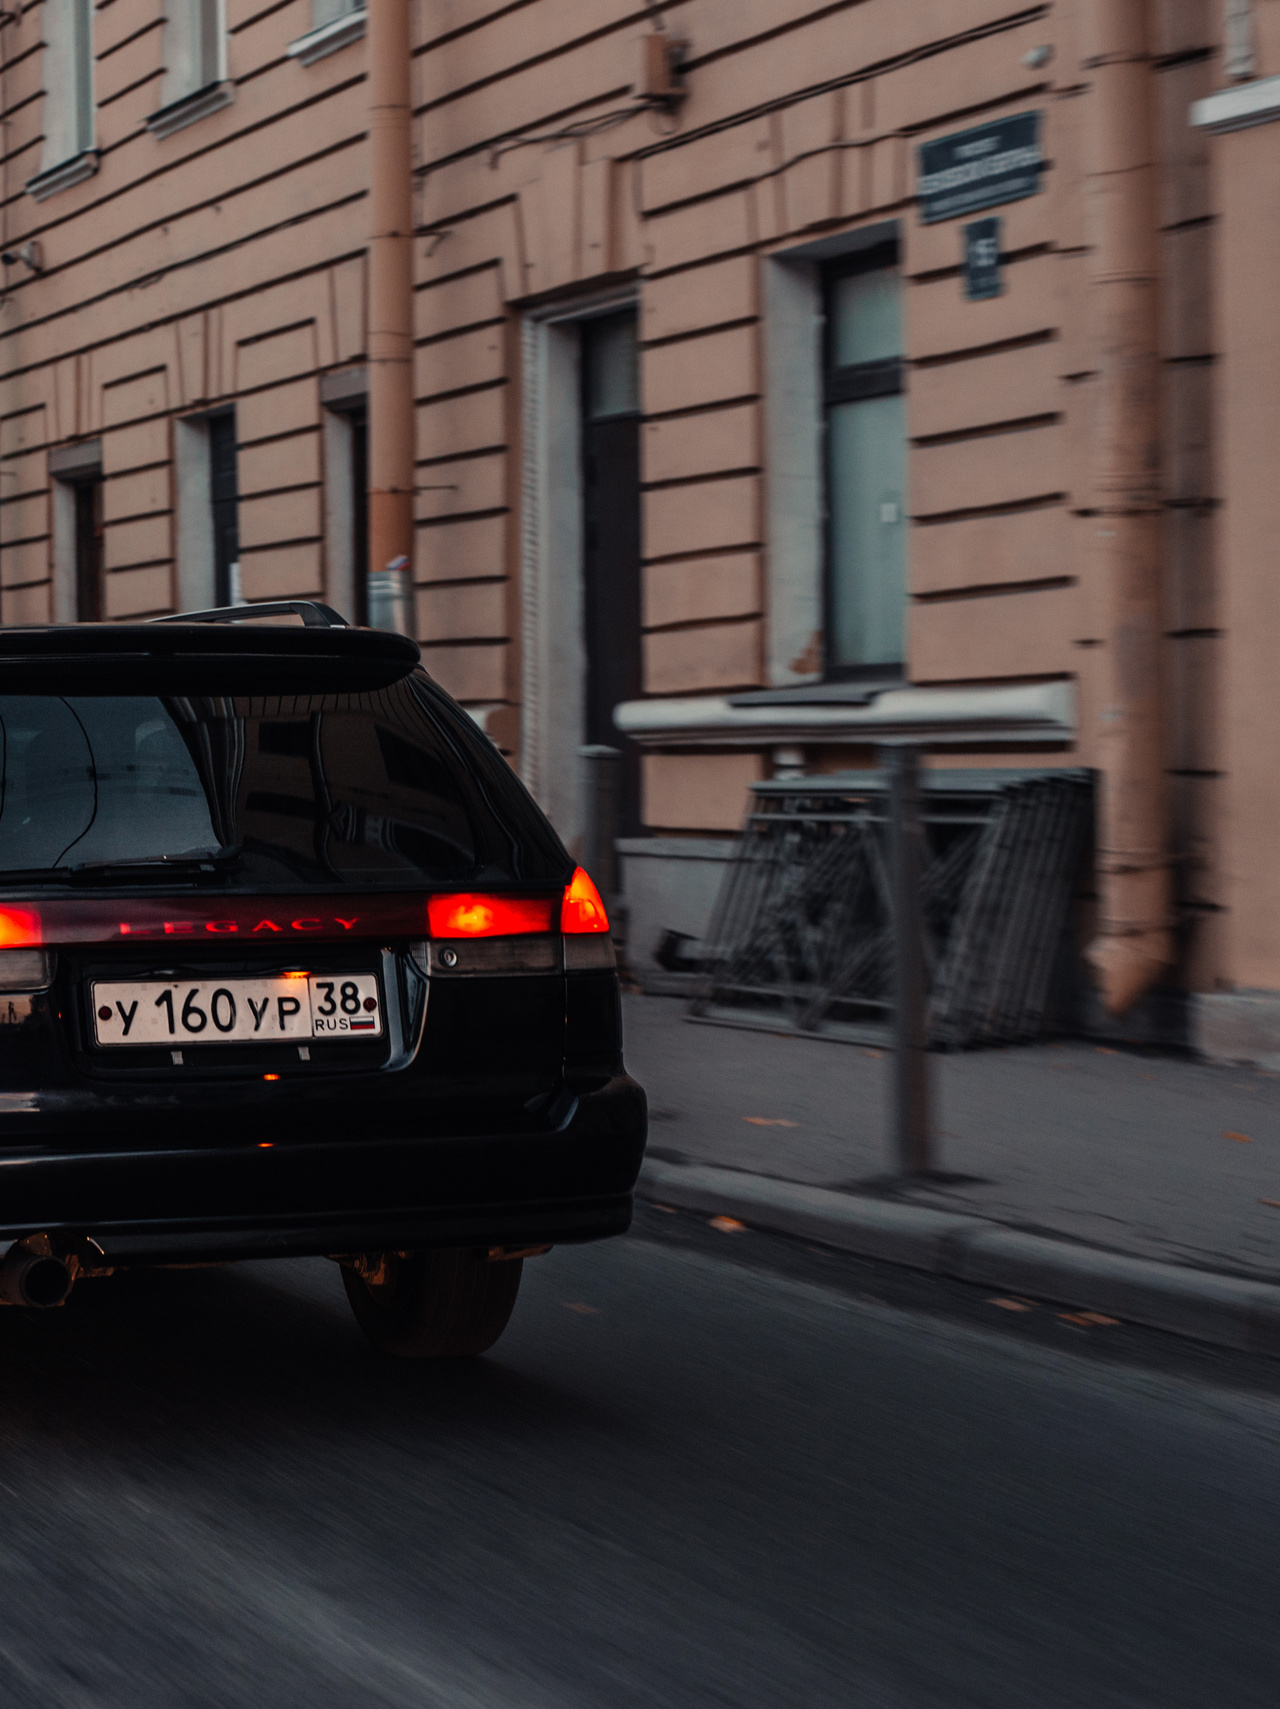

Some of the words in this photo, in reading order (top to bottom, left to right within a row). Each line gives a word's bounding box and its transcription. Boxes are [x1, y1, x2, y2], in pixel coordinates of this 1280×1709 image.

[119, 917, 360, 935] LEGACY
[315, 981, 361, 1015] 38
[315, 1017, 349, 1031] RUS
